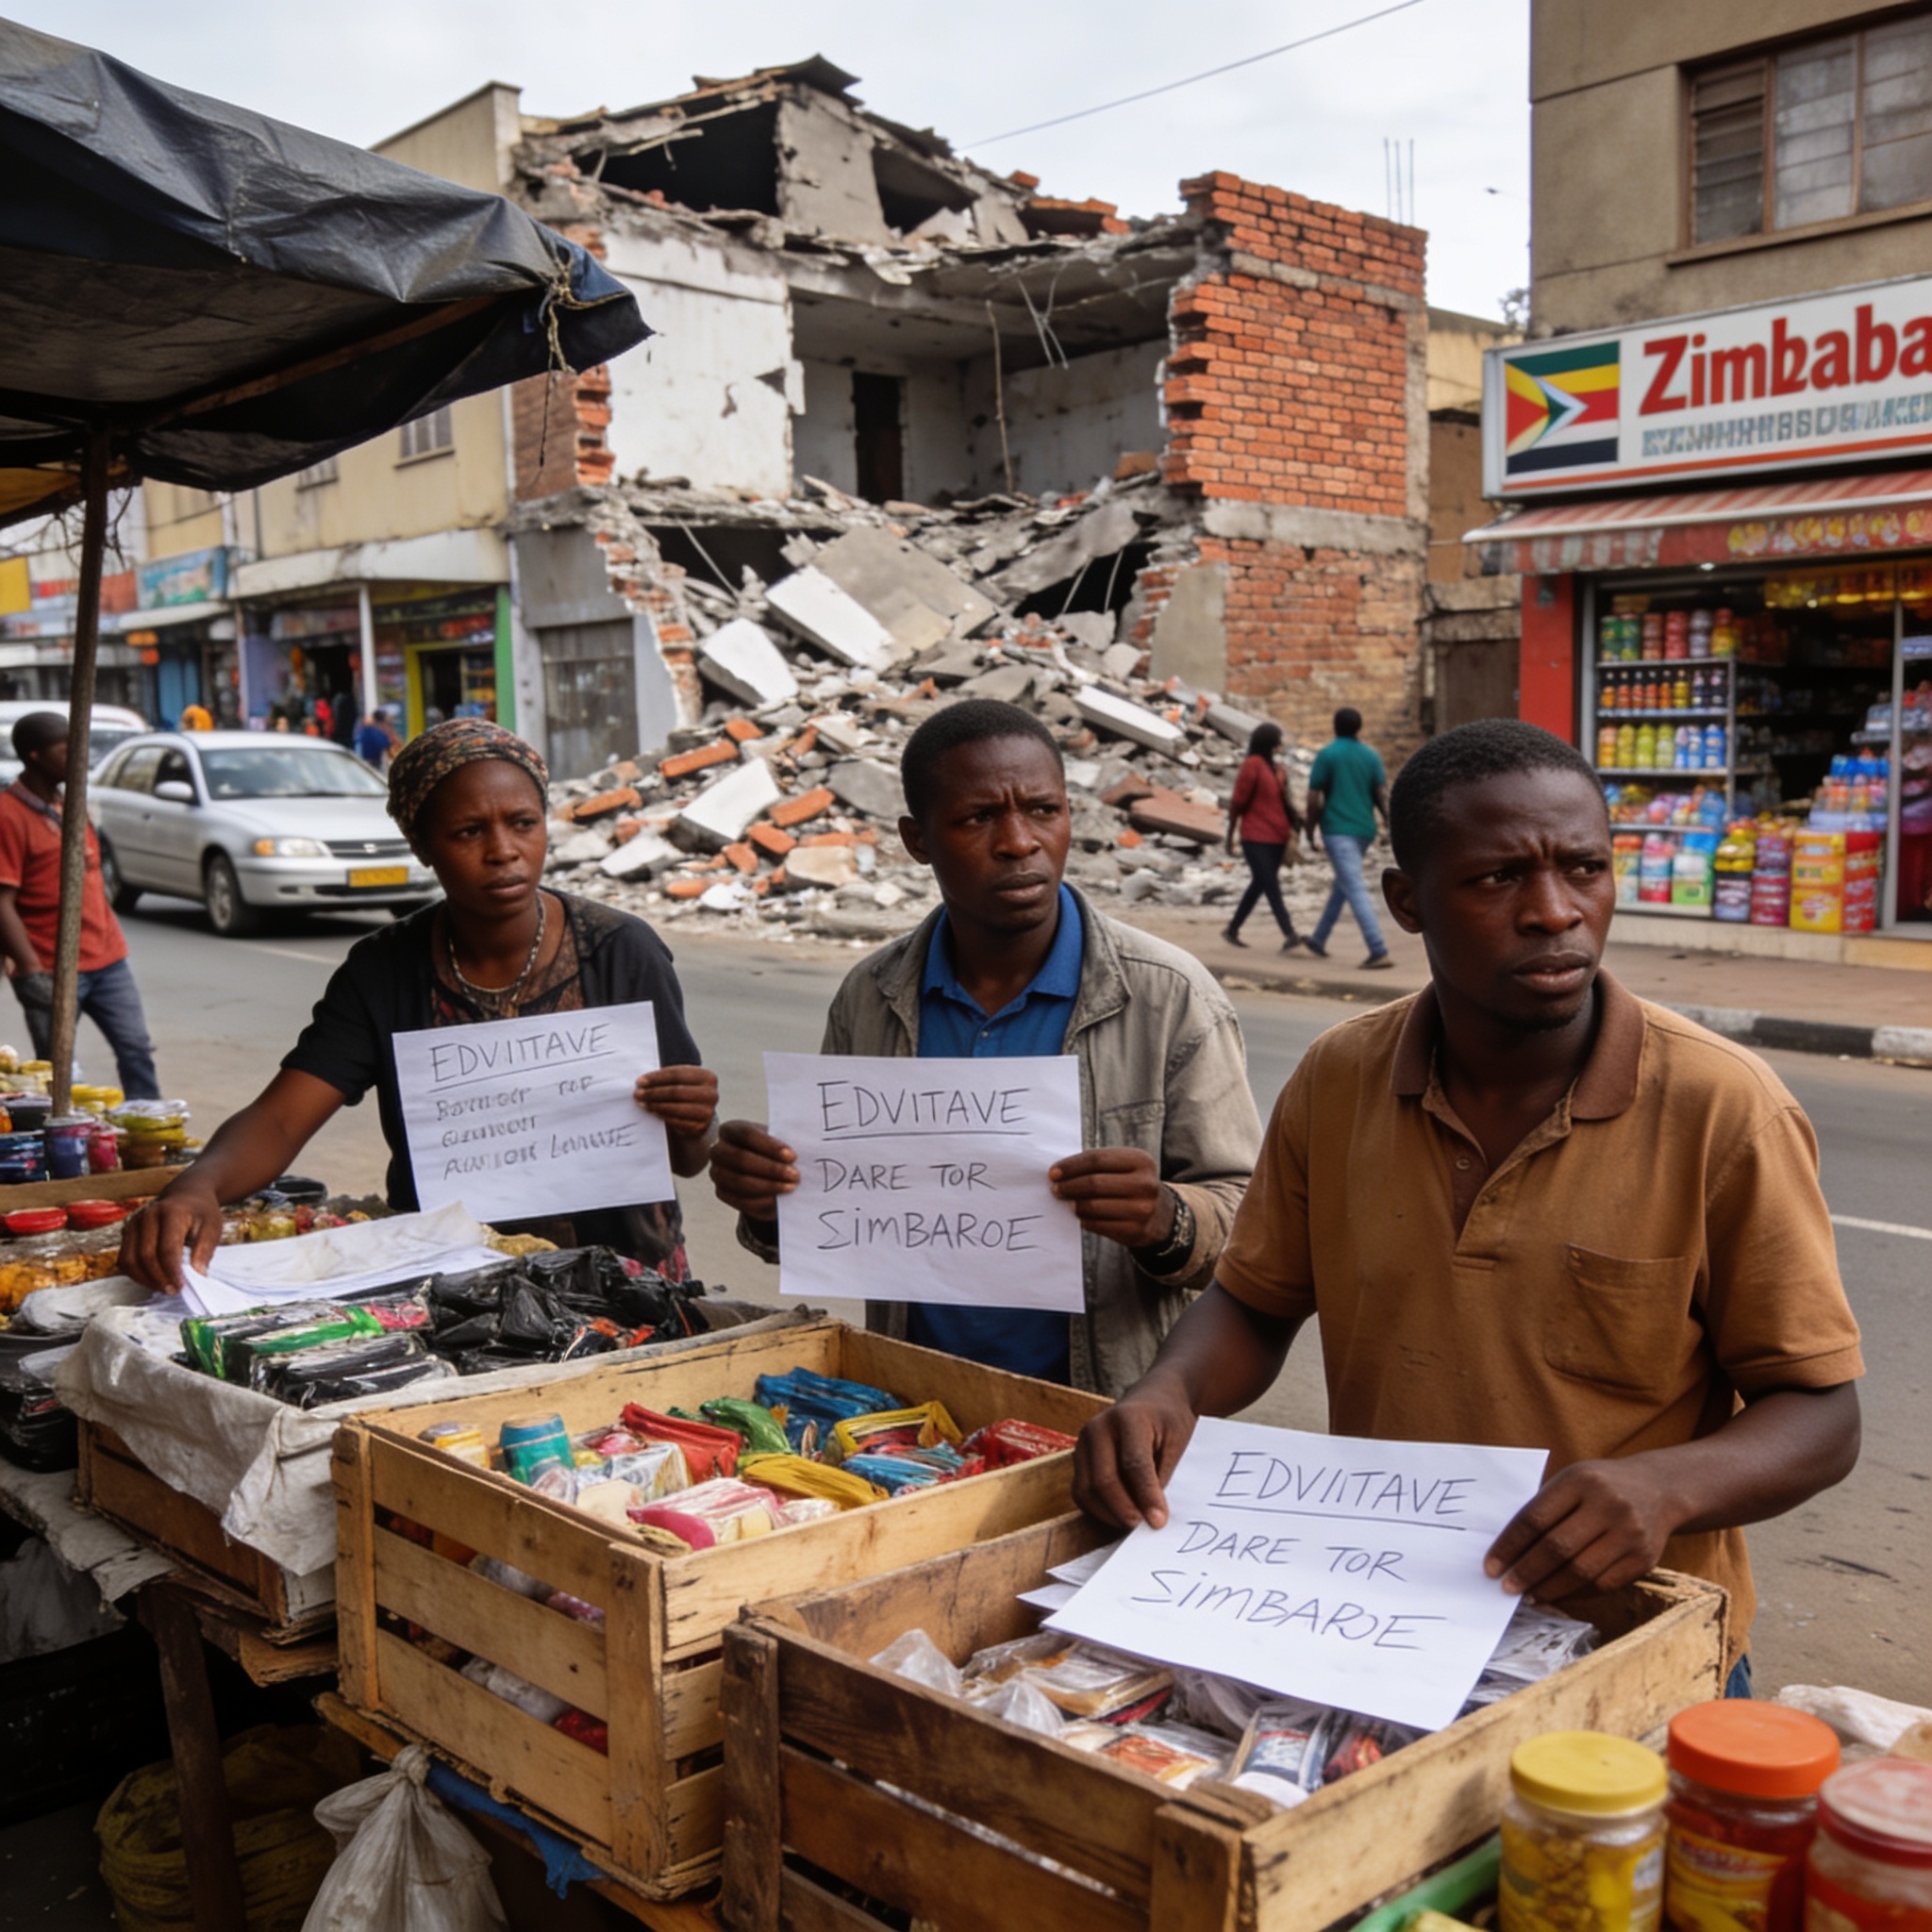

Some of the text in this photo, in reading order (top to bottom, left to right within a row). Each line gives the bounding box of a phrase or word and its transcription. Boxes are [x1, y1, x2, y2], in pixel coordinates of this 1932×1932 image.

[817, 1080, 1030, 1131] EDVITAVE
[814, 1158, 998, 1192] DARE TOR
[1176, 1521, 1407, 1582] DARE TOR
